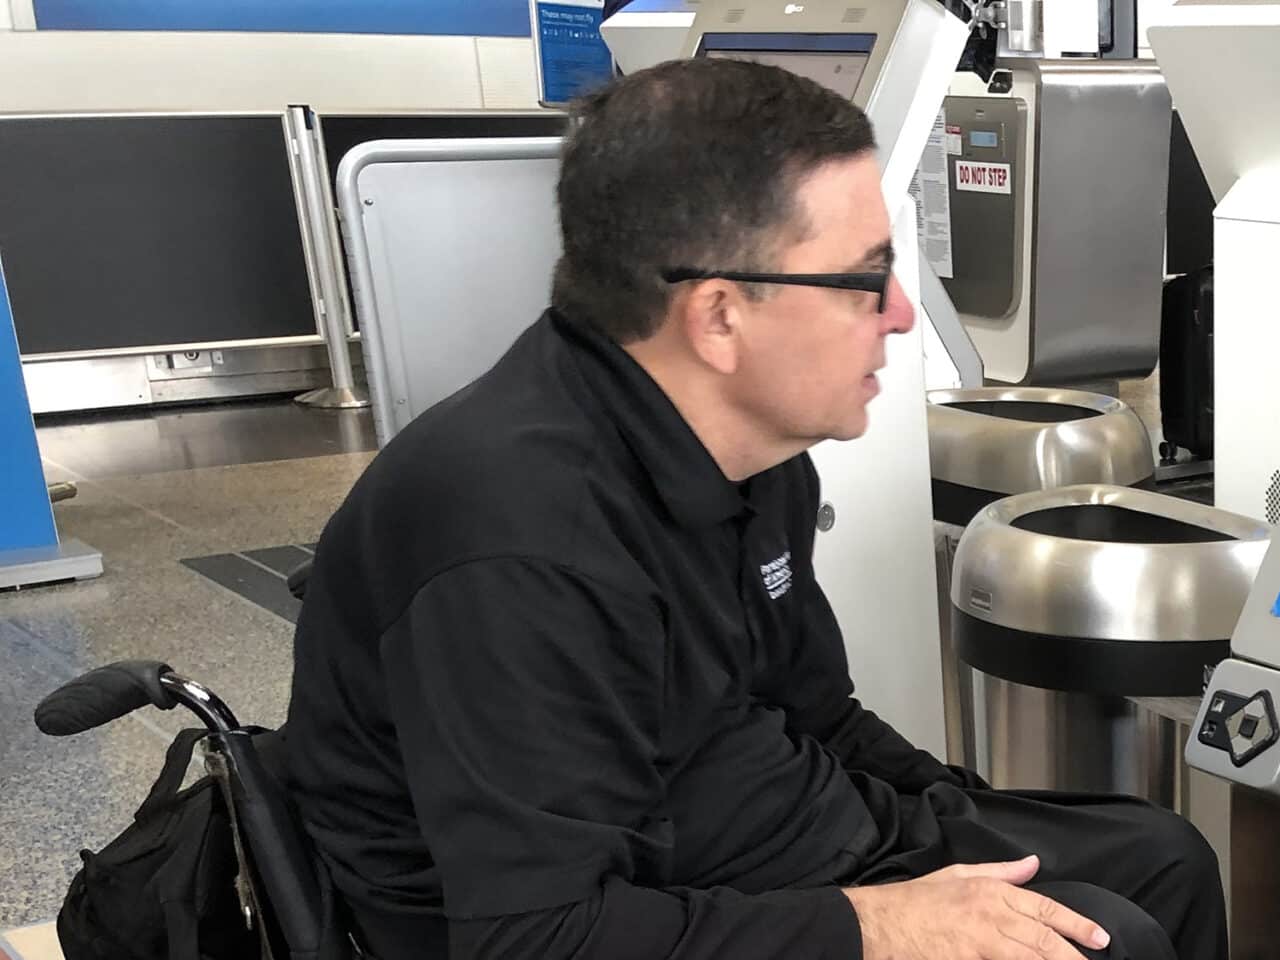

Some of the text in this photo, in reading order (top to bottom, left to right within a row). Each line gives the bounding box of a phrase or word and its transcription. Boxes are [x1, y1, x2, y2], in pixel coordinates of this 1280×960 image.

[959, 165, 1007, 187] DO NOT STEP
